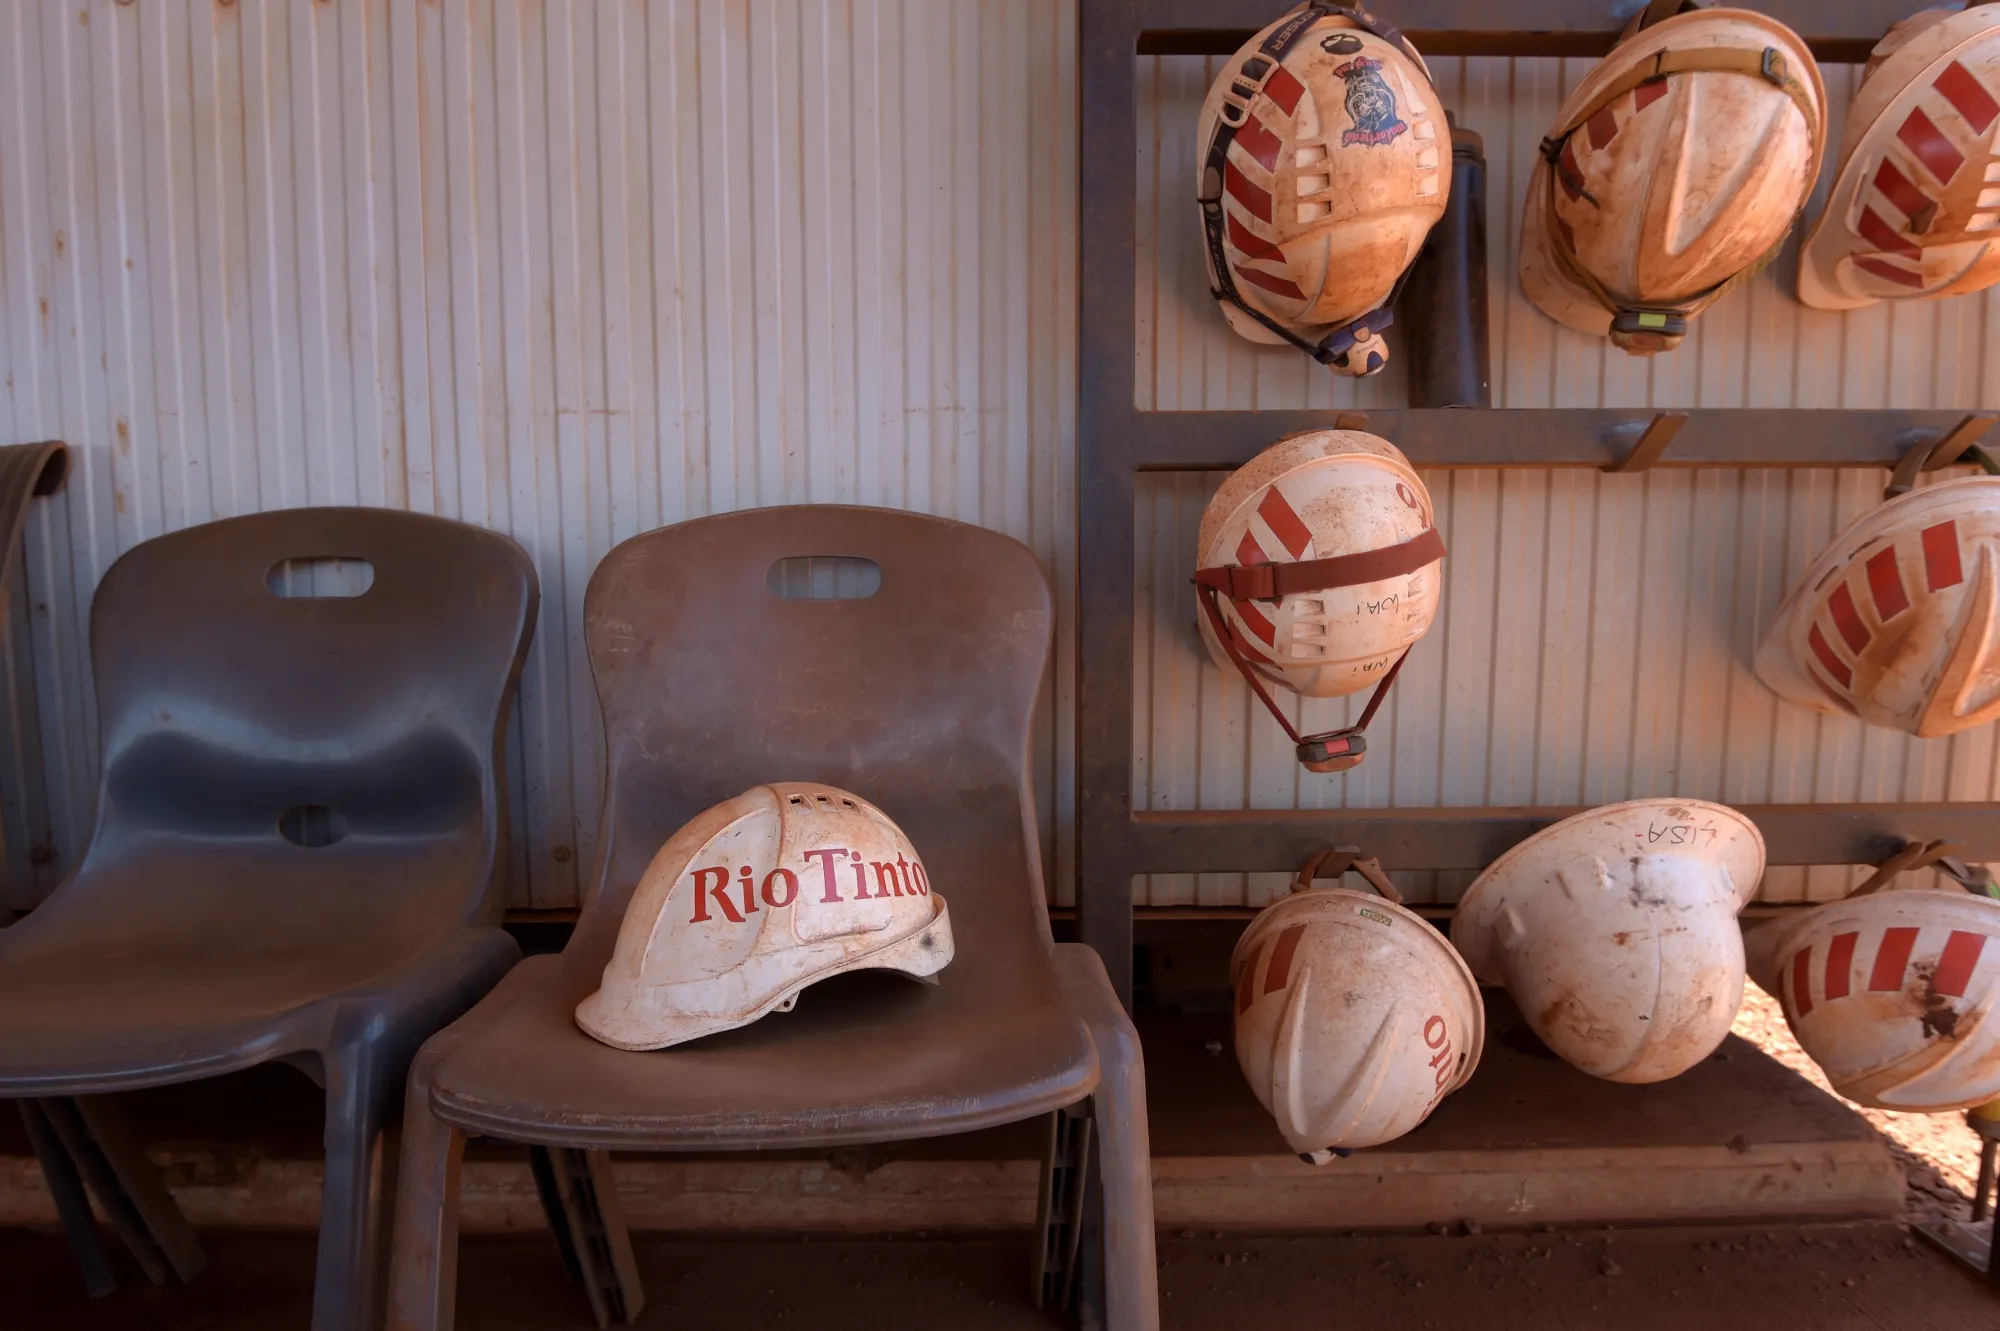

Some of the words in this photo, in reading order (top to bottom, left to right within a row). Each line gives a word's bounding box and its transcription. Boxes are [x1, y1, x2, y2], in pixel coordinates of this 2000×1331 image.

[1647, 822, 1718, 848] LISA
[689, 864, 799, 924] Rio
[804, 848, 928, 903] Tinto
[1362, 909, 1391, 926] MSA
